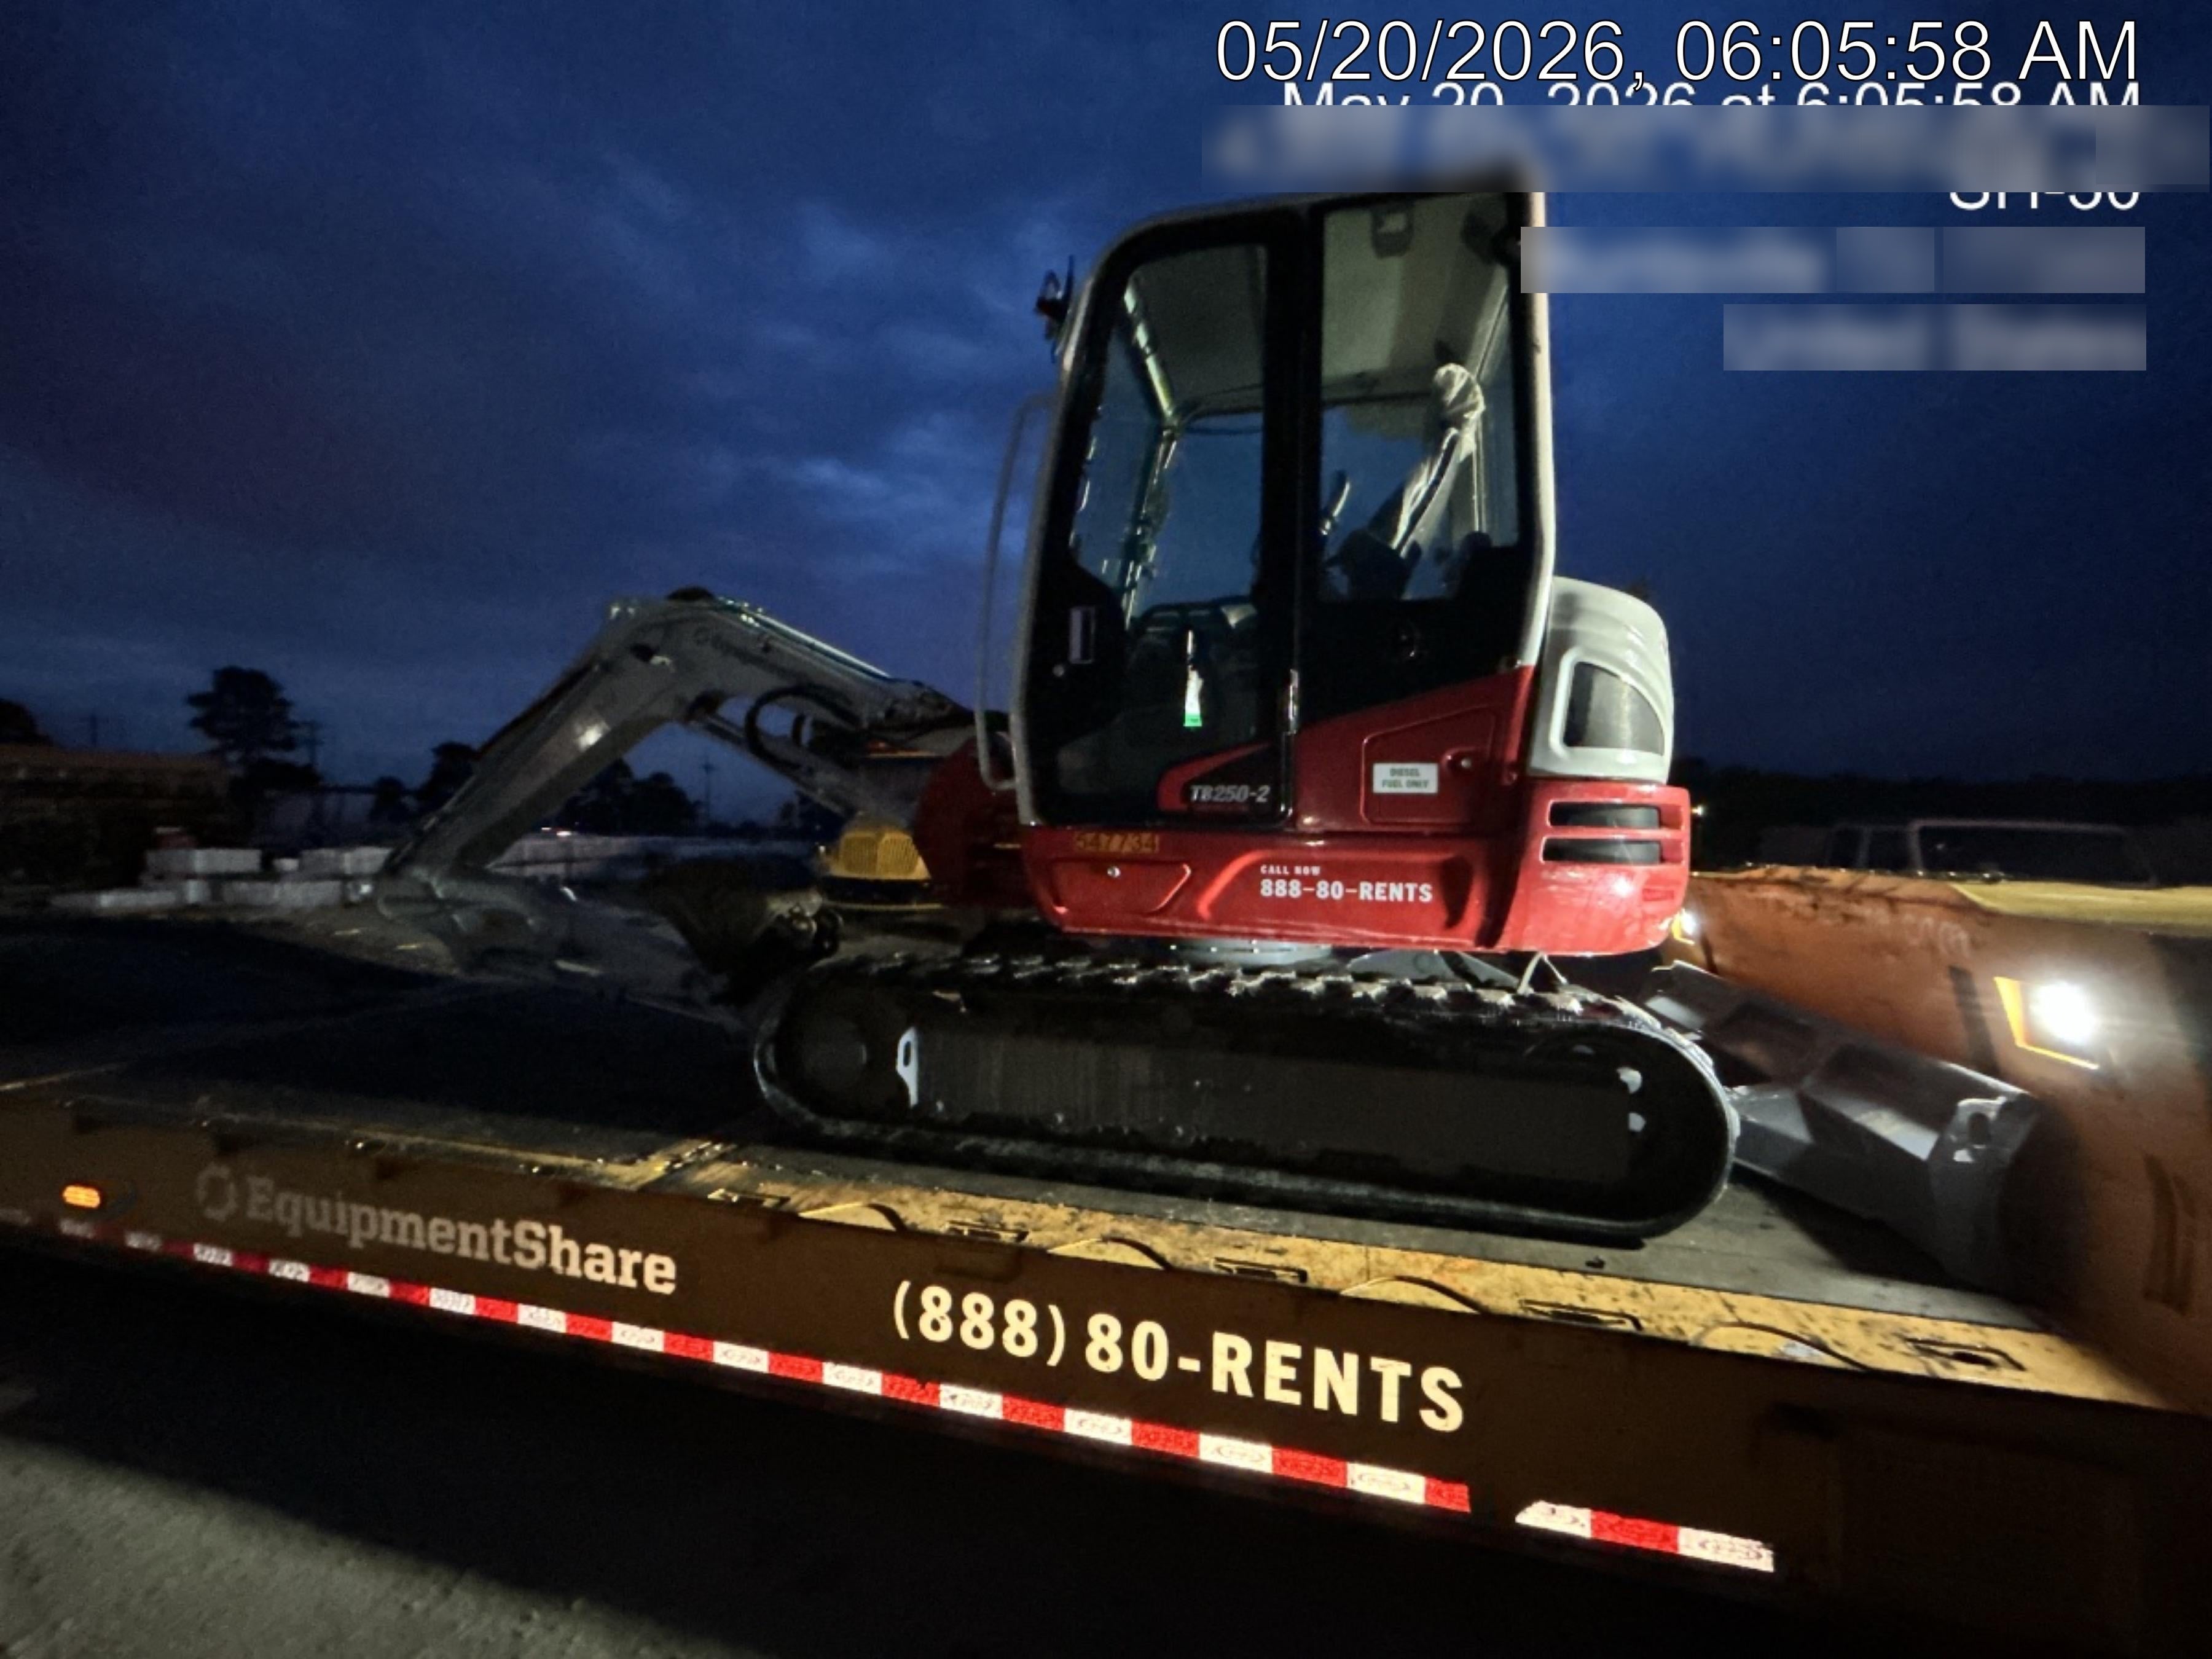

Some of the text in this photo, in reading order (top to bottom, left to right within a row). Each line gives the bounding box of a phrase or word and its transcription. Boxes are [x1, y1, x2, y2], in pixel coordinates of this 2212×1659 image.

[1191, 785, 1271, 802] TB250-2
[1260, 865, 1320, 875] CALL NOW
[1260, 879, 1433, 903] 888-80-RENTS
[246, 1176, 677, 1295] EquipmentShare
[893, 1280, 1464, 1432] (888) 80-RENTS
